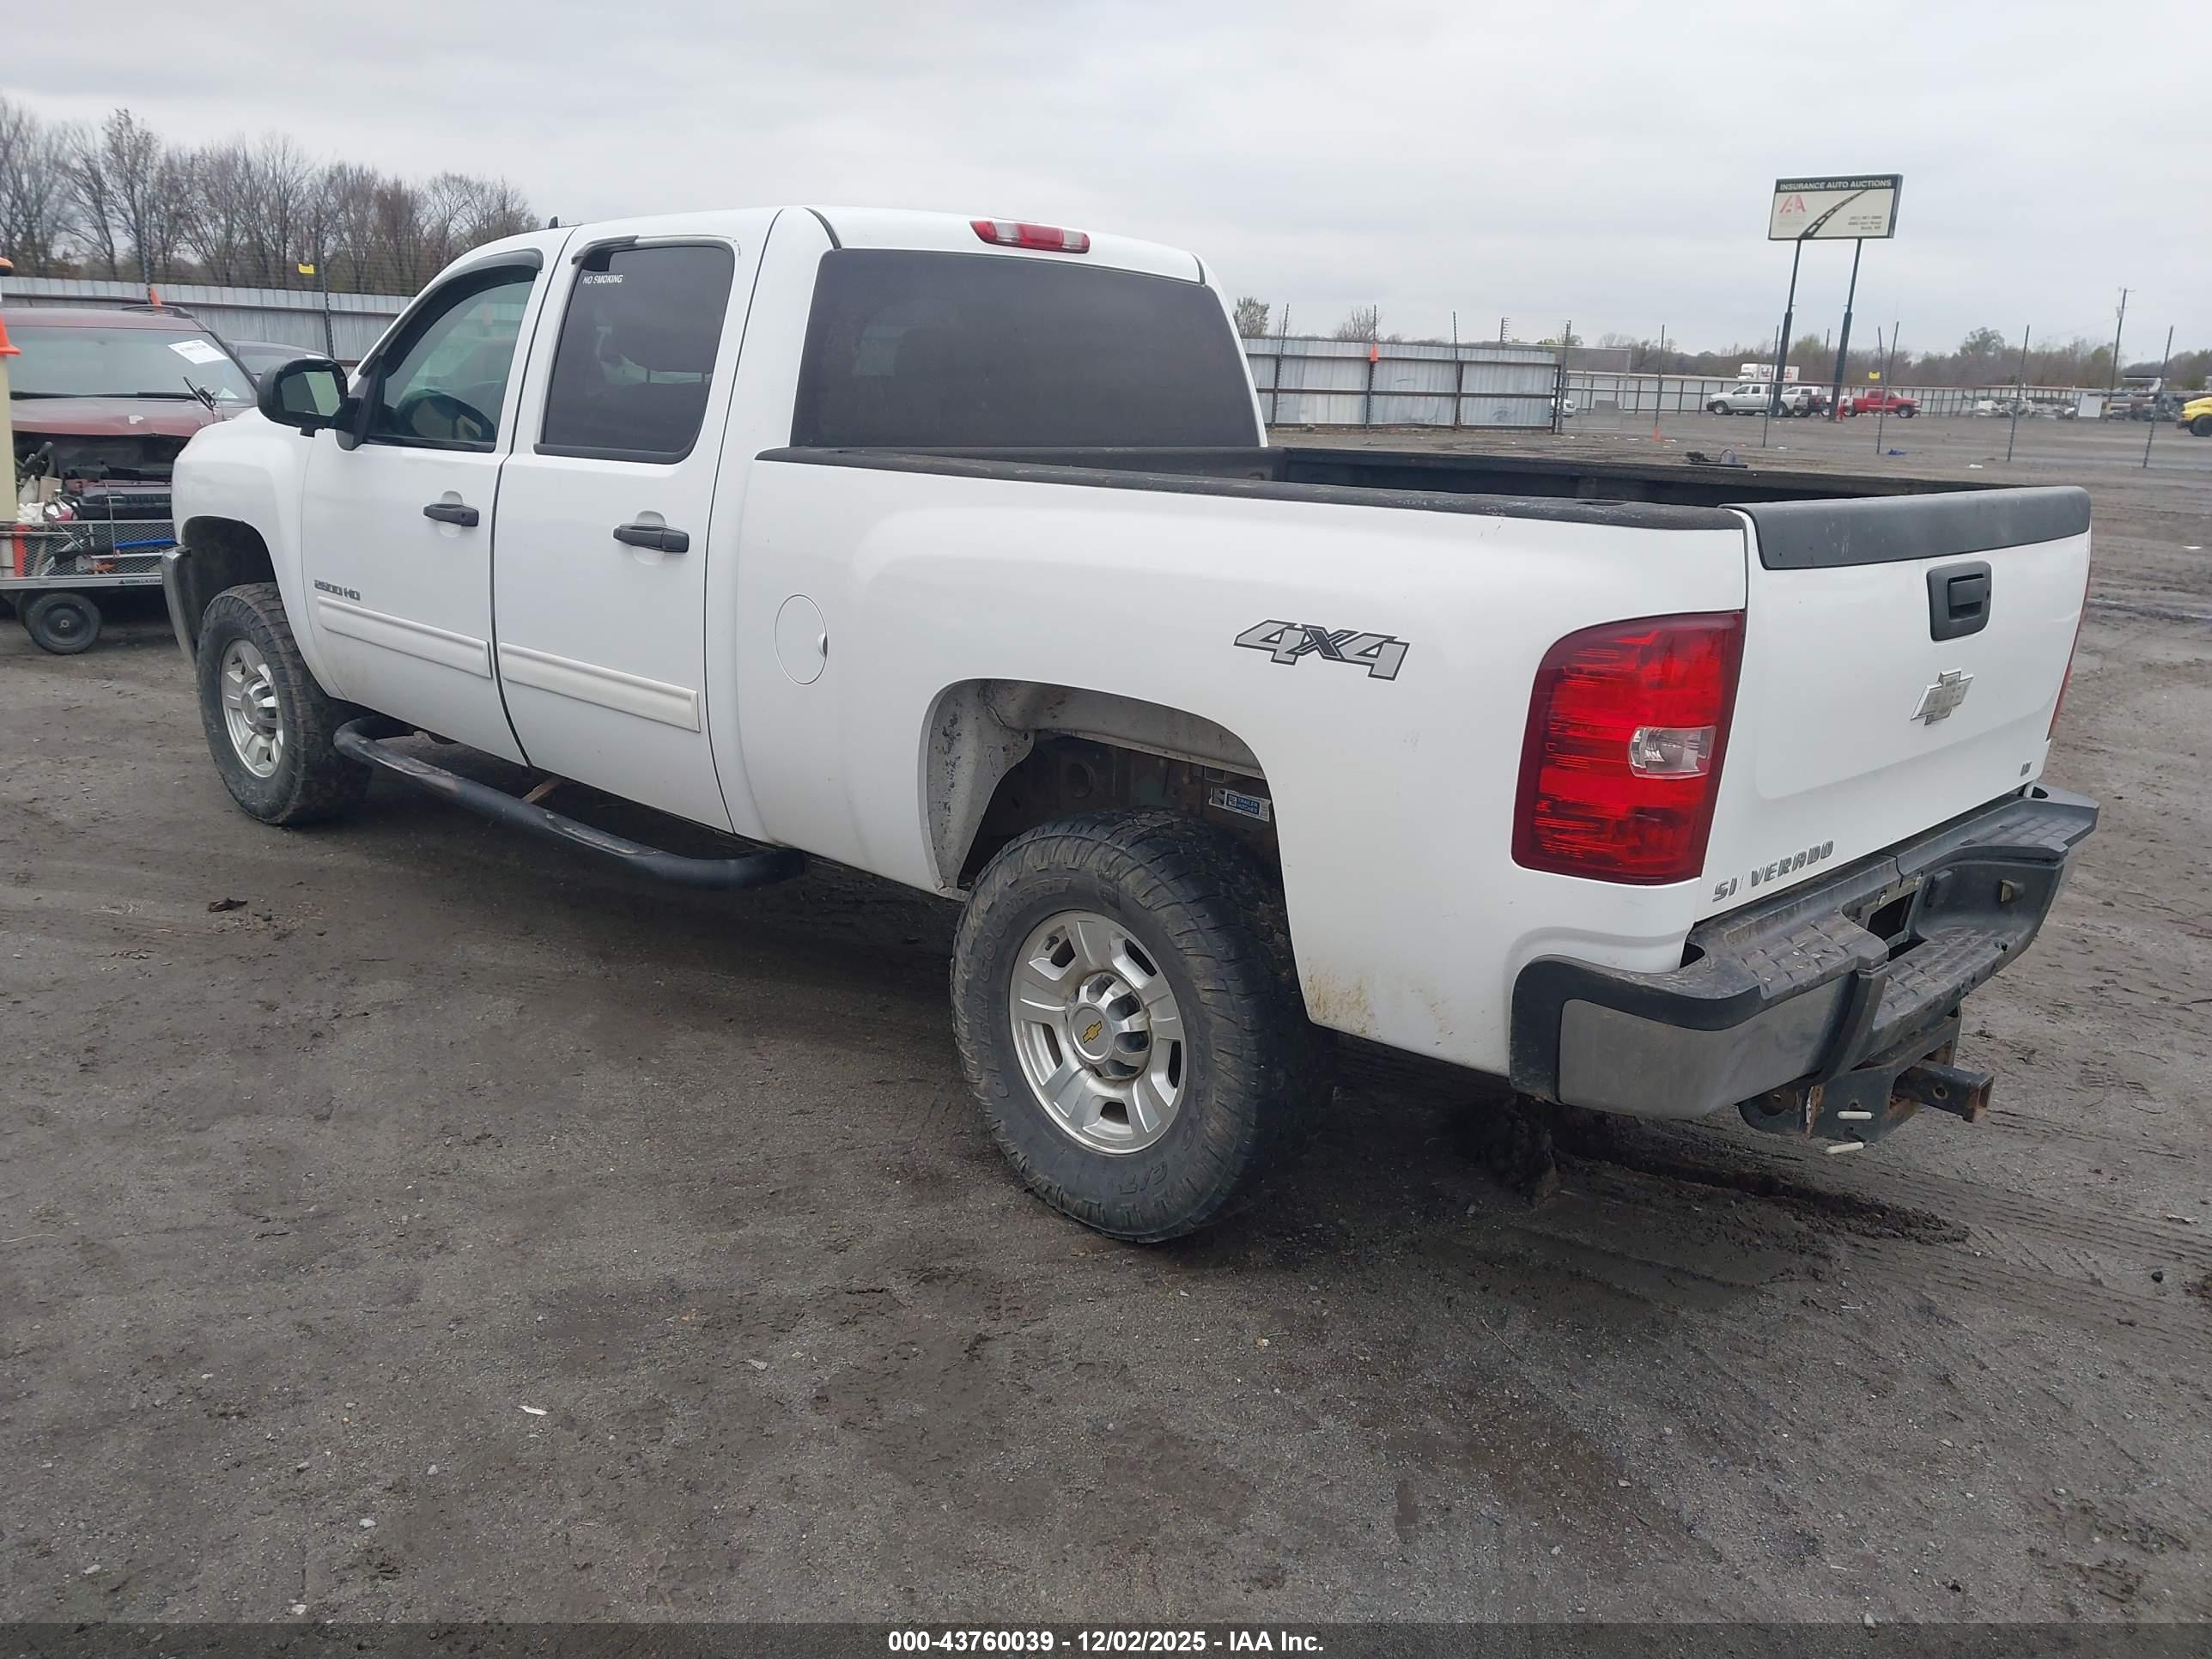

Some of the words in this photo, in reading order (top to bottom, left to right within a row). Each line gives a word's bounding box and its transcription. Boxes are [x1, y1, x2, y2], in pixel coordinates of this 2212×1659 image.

[1779, 181, 1825, 191] INSURANCE
[1826, 180, 1849, 189] AUTO
[1850, 179, 1893, 188] AUCTIONS
[582, 275, 593, 284] NO
[592, 274, 624, 284] SMOKING
[313, 580, 343, 597] 2500
[343, 586, 362, 601] HD
[1237, 797, 1259, 808] TRAILER
[1712, 840, 1834, 902] SIVERADO
